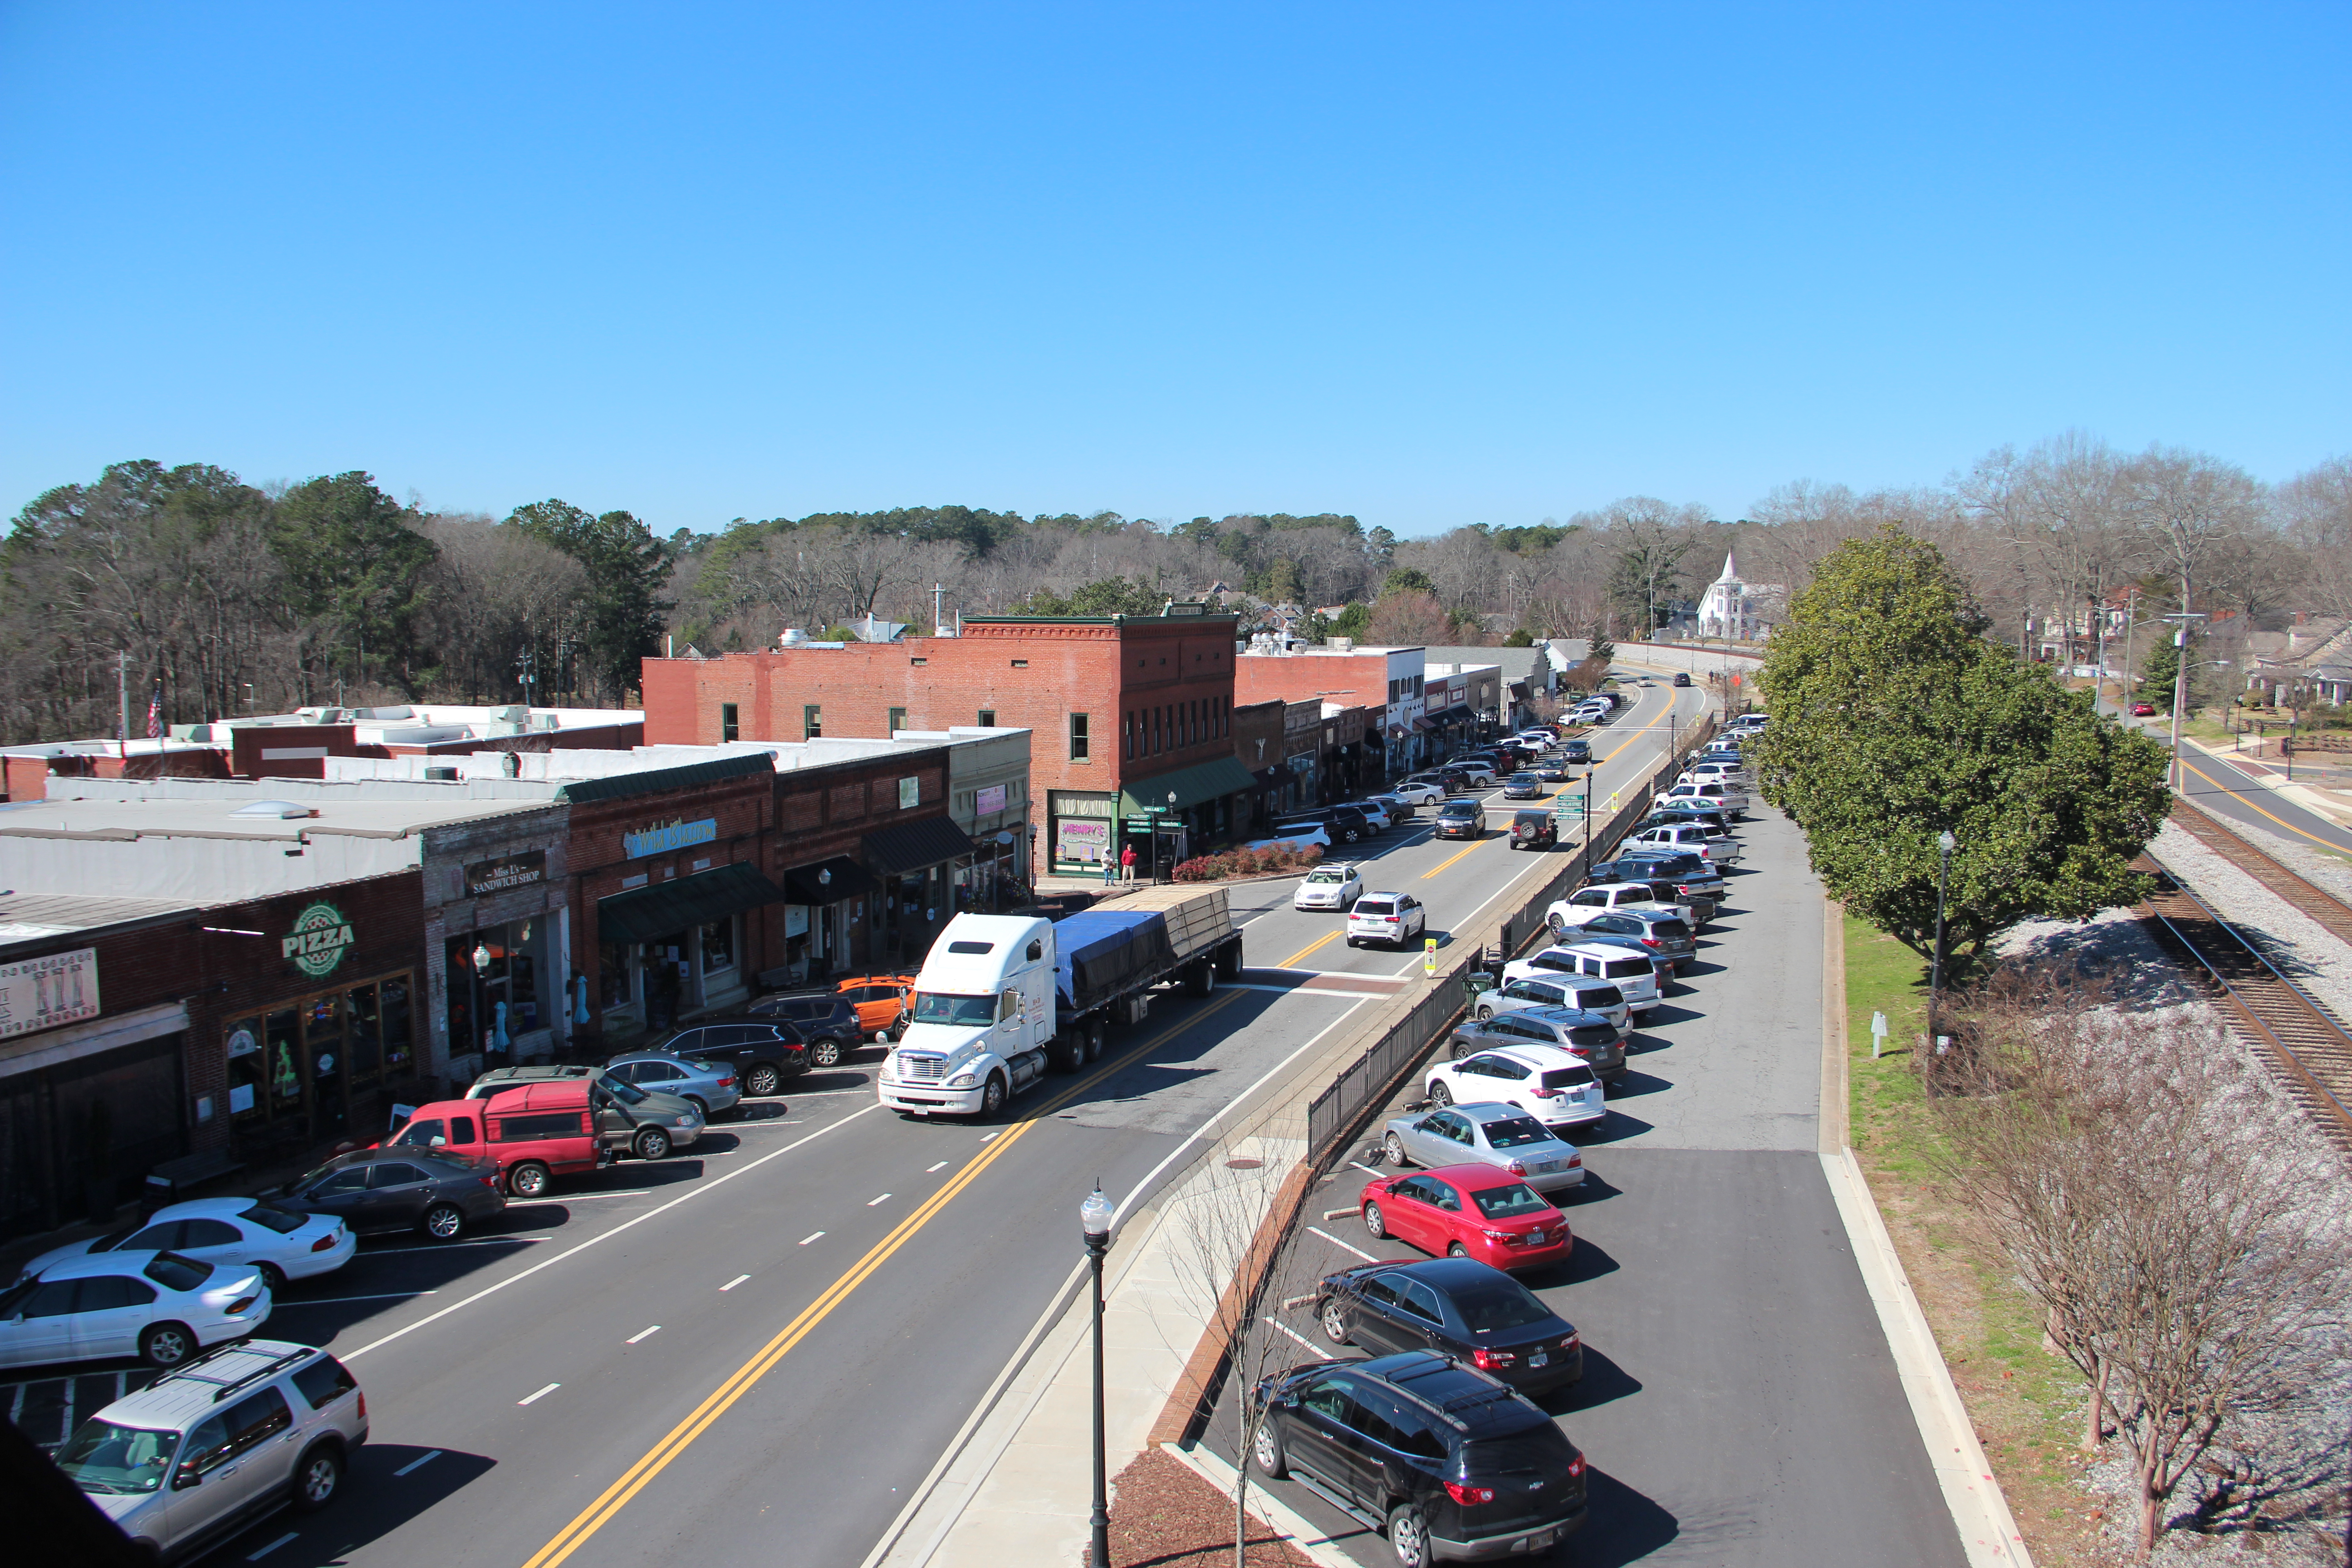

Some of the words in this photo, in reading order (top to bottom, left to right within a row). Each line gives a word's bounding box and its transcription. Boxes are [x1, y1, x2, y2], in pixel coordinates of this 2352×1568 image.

[635, 819, 666, 855] Wild
[670, 816, 718, 848] Blossom
[1063, 823, 1104, 837] HENRY'S
[473, 875, 518, 893] SANDWICH
[519, 870, 539, 883] SHOP
[494, 867, 509, 878] Miss
[510, 864, 519, 874] L's
[281, 925, 354, 958] PIZZA
